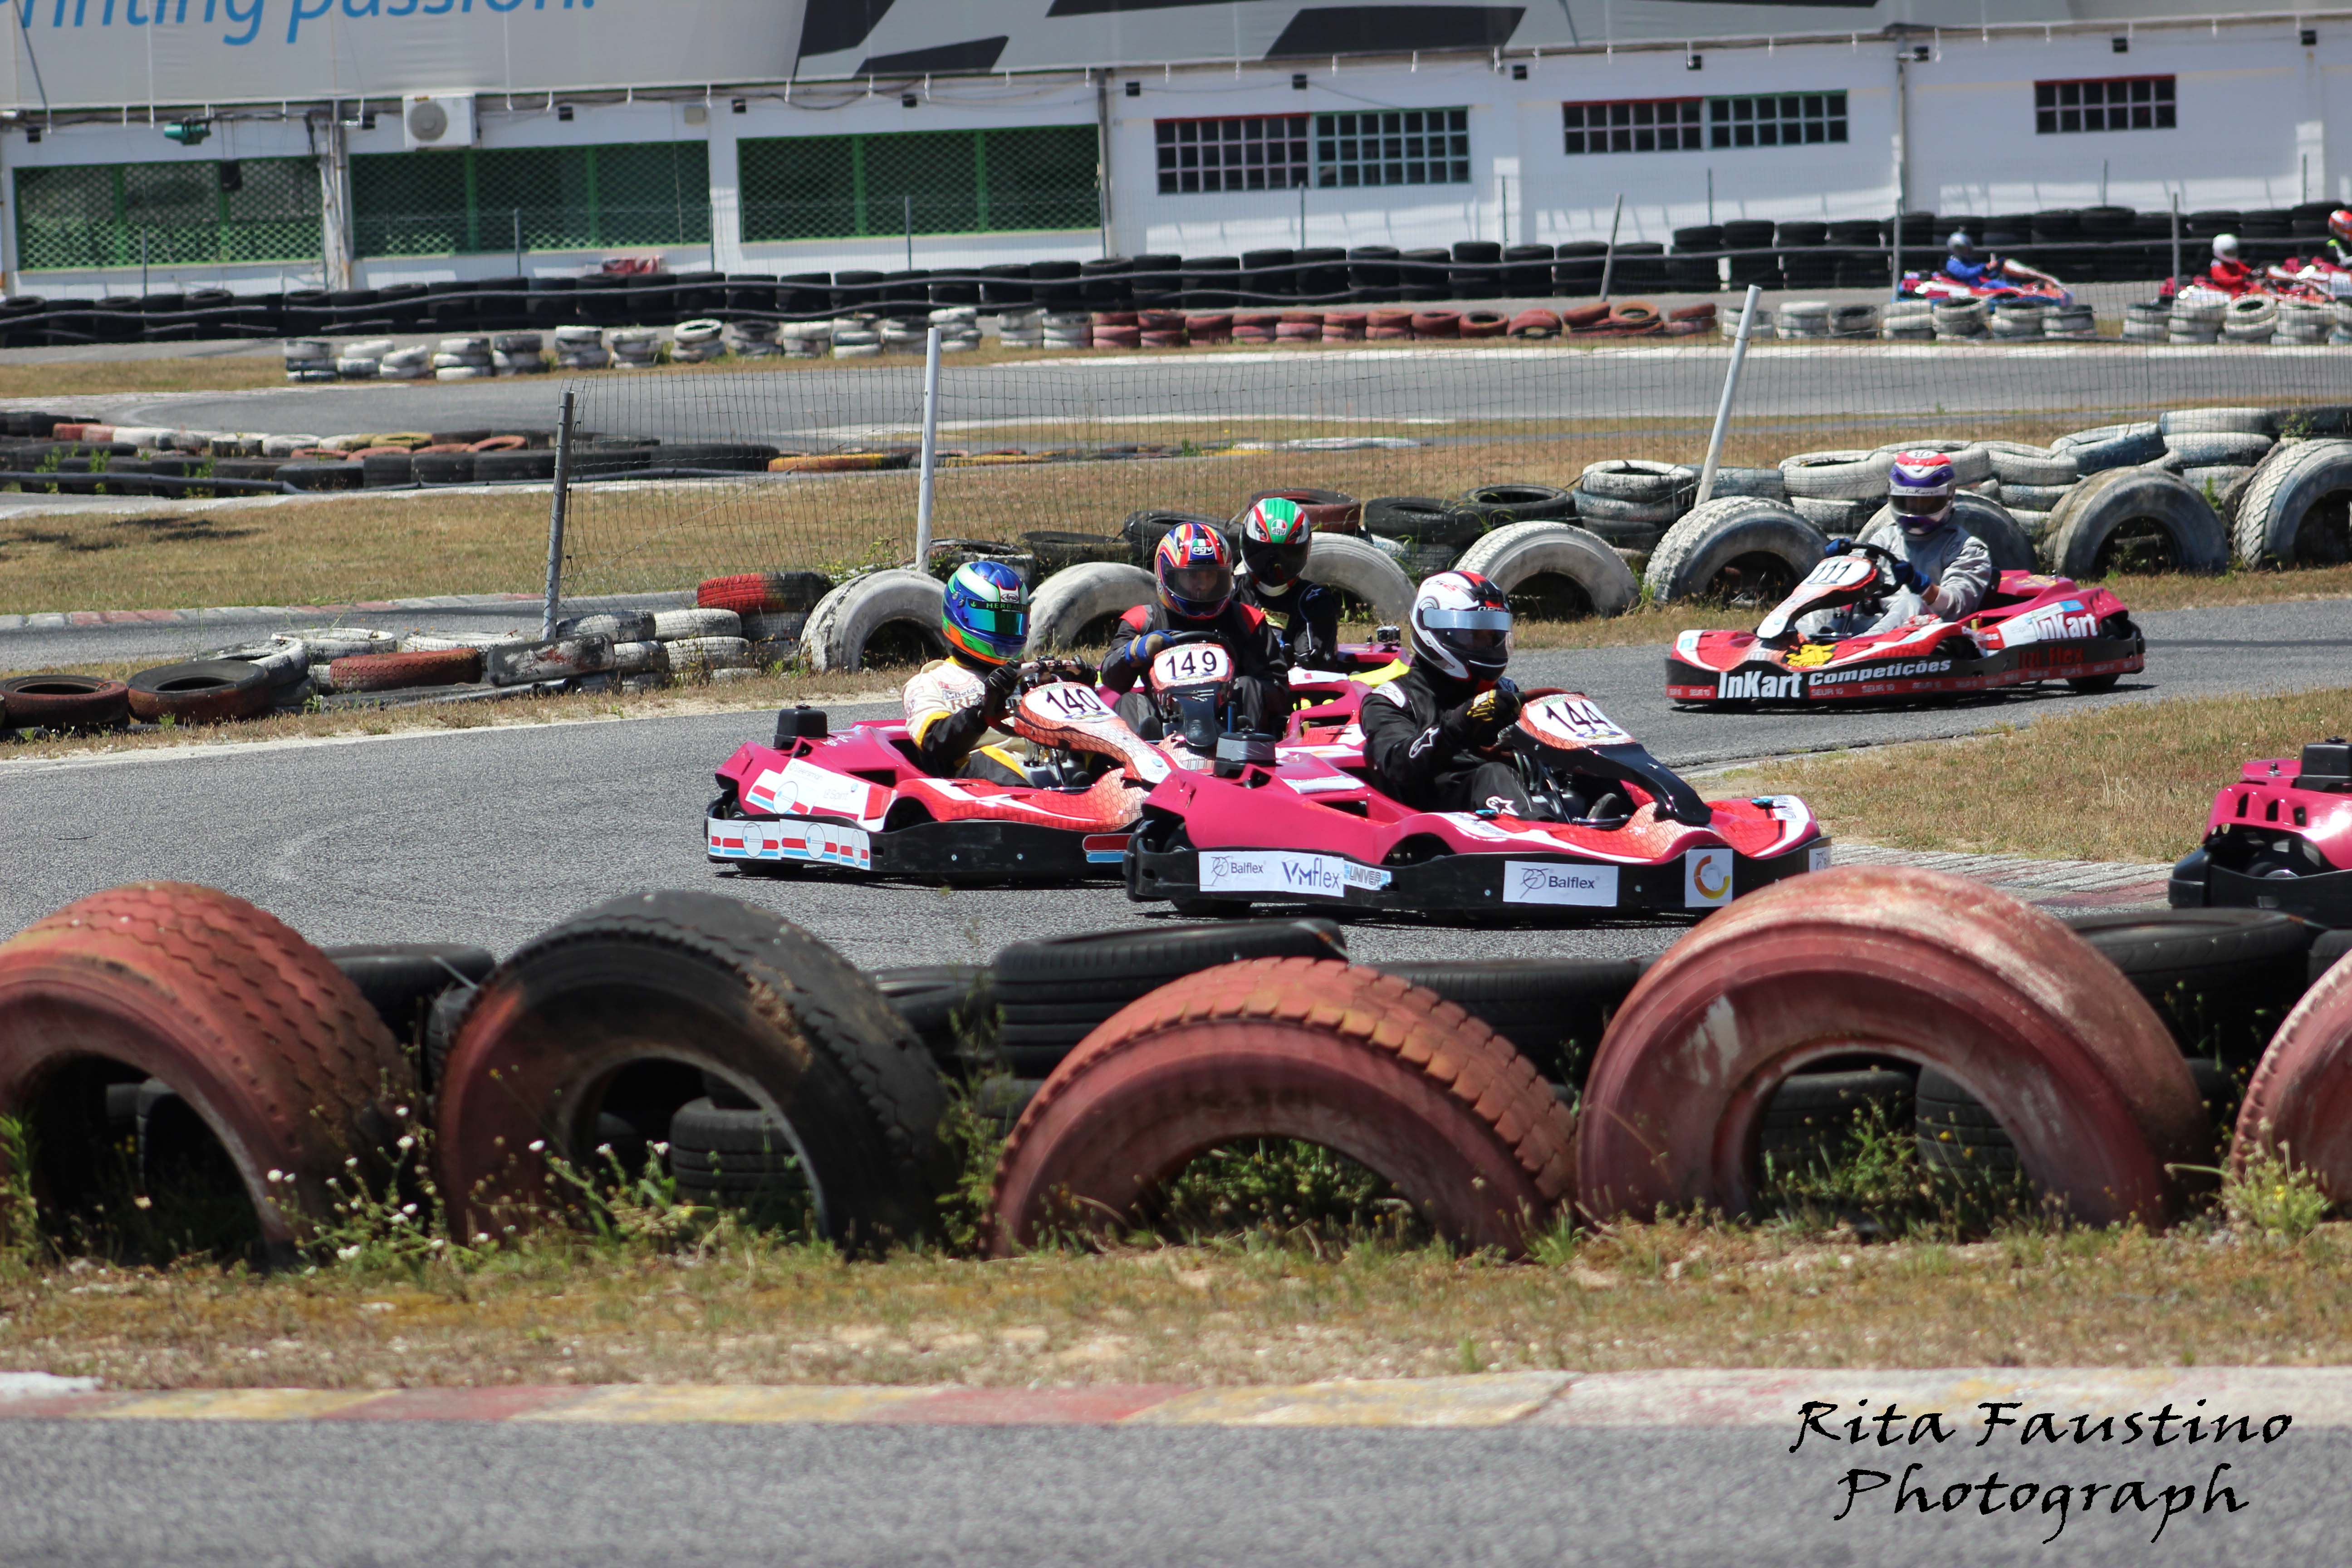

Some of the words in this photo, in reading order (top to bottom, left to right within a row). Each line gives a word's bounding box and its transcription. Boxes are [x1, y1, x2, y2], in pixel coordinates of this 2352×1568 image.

[1272, 527, 1286, 535] agv
[1808, 562, 1852, 583] 111
[2033, 613, 2097, 640] InKart
[1166, 651, 1217, 677] 149
[1808, 659, 1951, 686] Competições
[1717, 671, 1803, 699] InKart
[1811, 688, 1833, 696] SEUR
[1046, 688, 1101, 714] 140
[1546, 701, 1613, 733] 144
[1230, 862, 1263, 874] Balflex
[1548, 876, 1595, 889] Balflex
